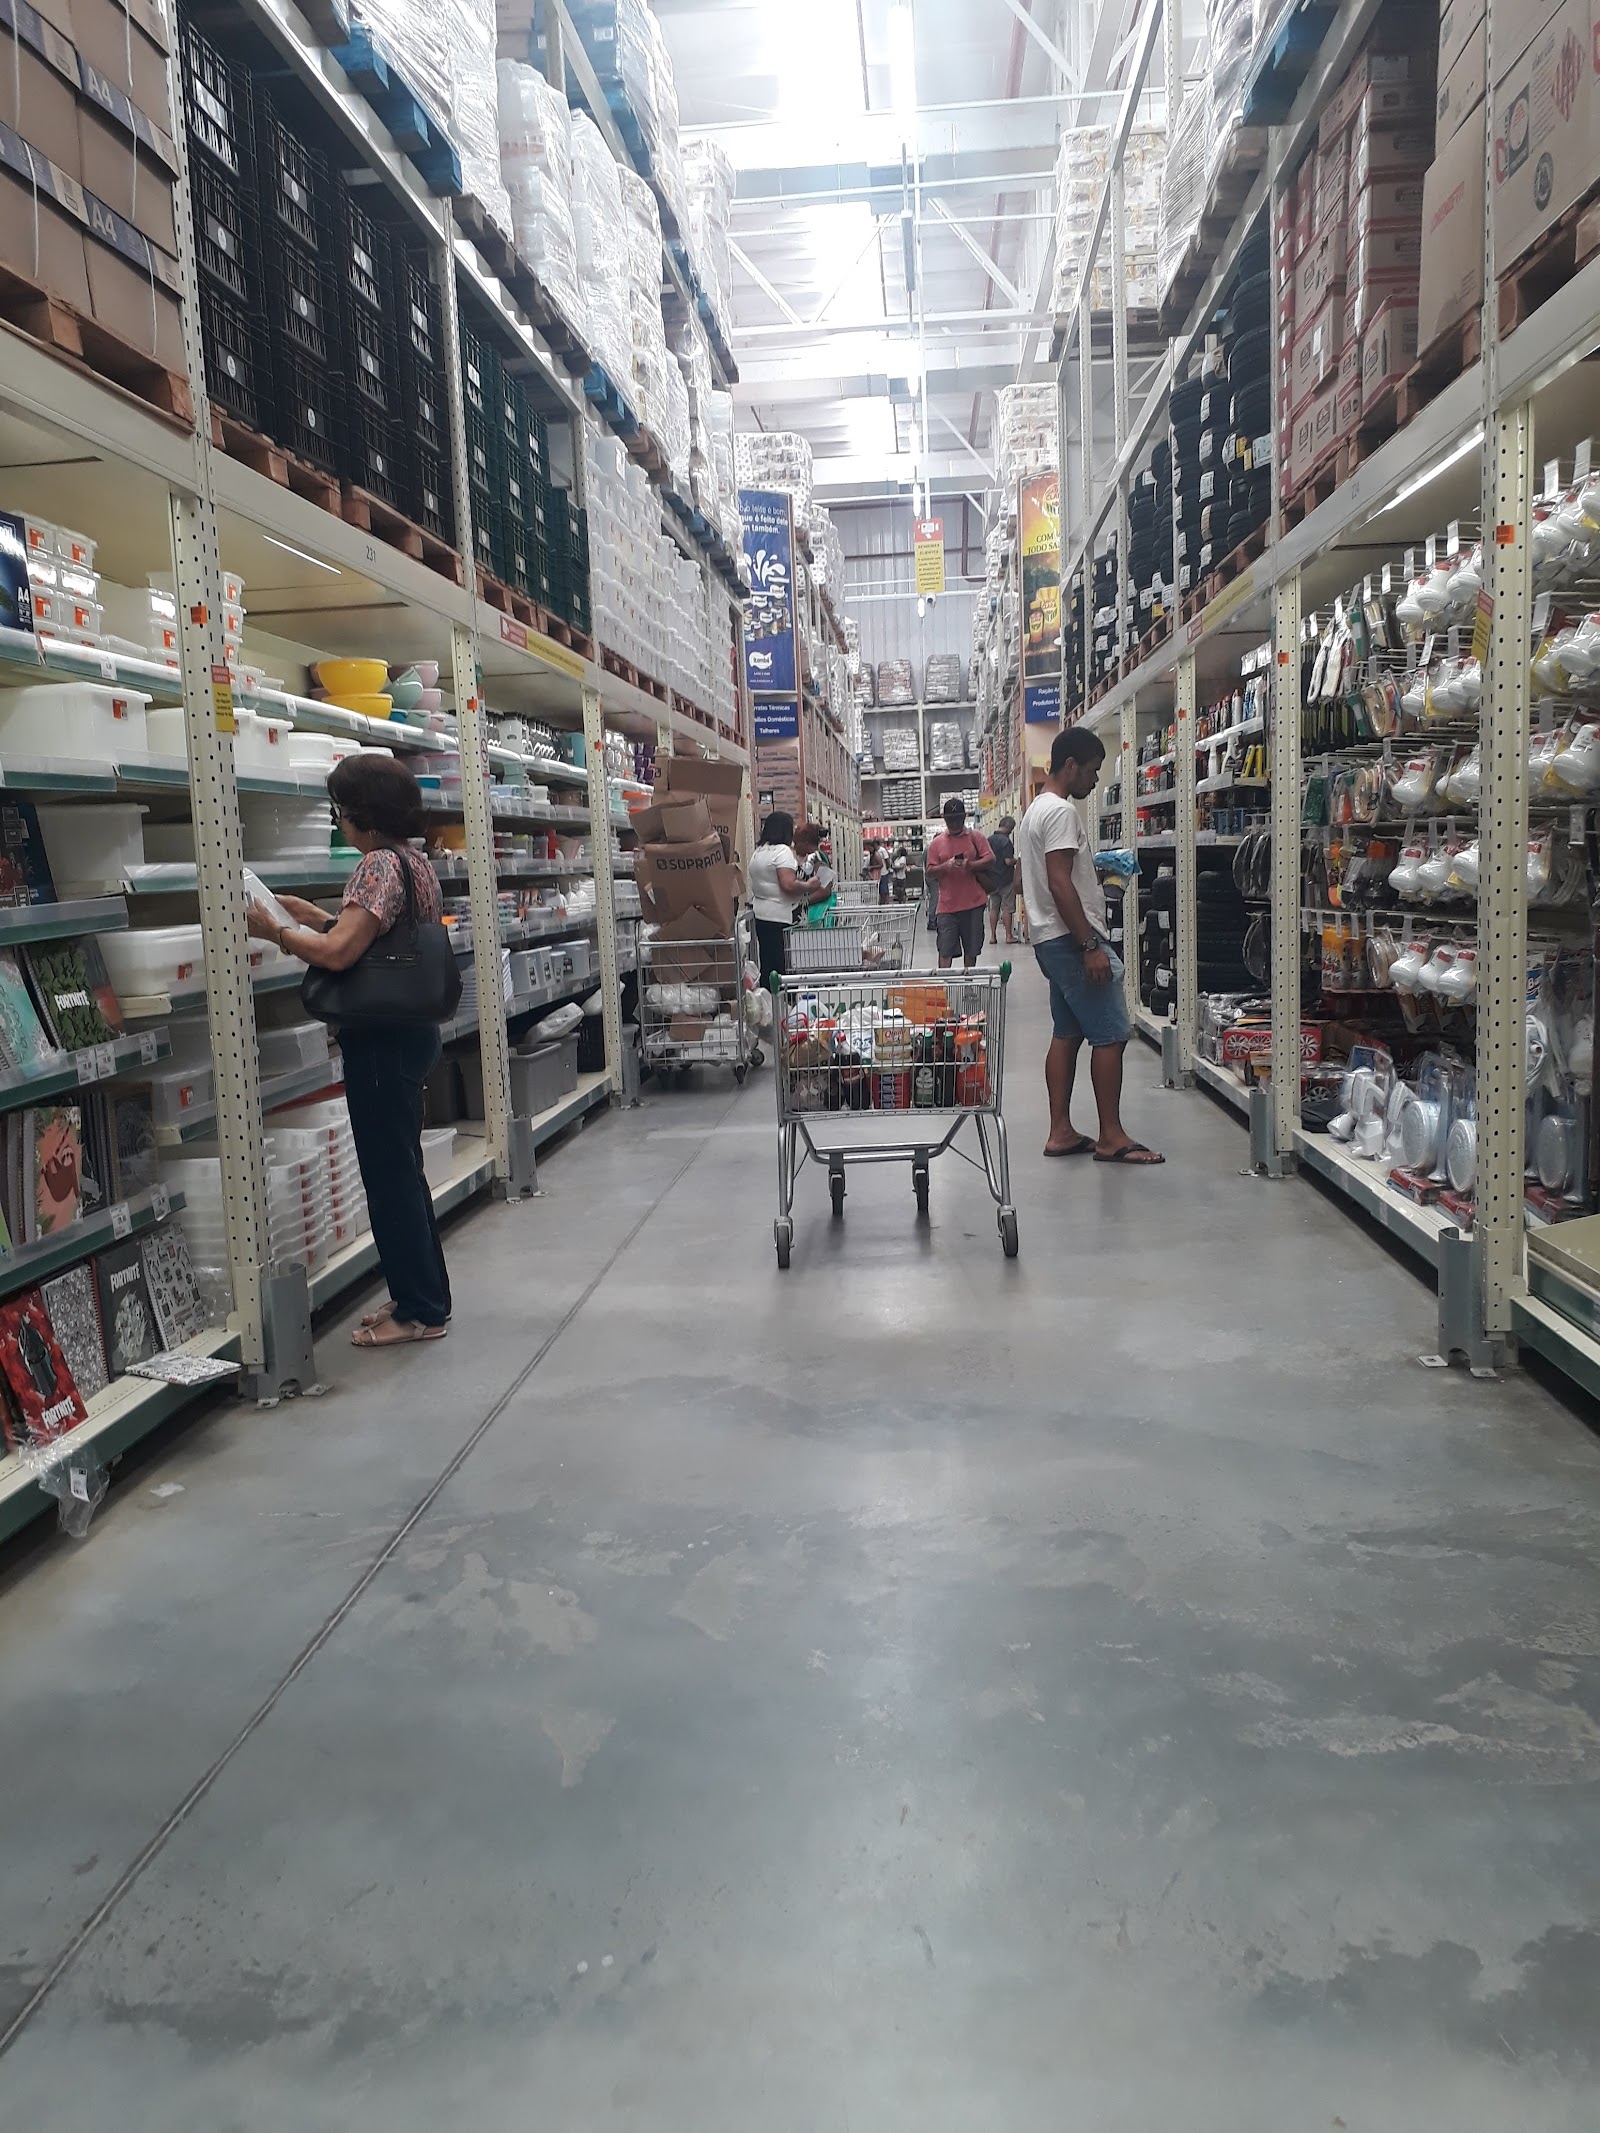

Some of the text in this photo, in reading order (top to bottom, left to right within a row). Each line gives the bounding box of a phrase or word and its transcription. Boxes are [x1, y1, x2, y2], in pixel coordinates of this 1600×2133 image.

[88, 66, 114, 109] A4
[92, 202, 118, 243] A4
[1036, 532, 1054, 543] COM
[1027, 543, 1047, 555] TODO
[18, 586, 30, 604] A4
[1032, 699, 1054, 707] Produtos
[767, 715, 795, 723] Domésticos
[670, 850, 721, 870] SOPRANO
[54, 989, 90, 1012] FORTNITE
[110, 1261, 141, 1294] FORTNITE
[41, 1396, 76, 1429] FORTNITE
